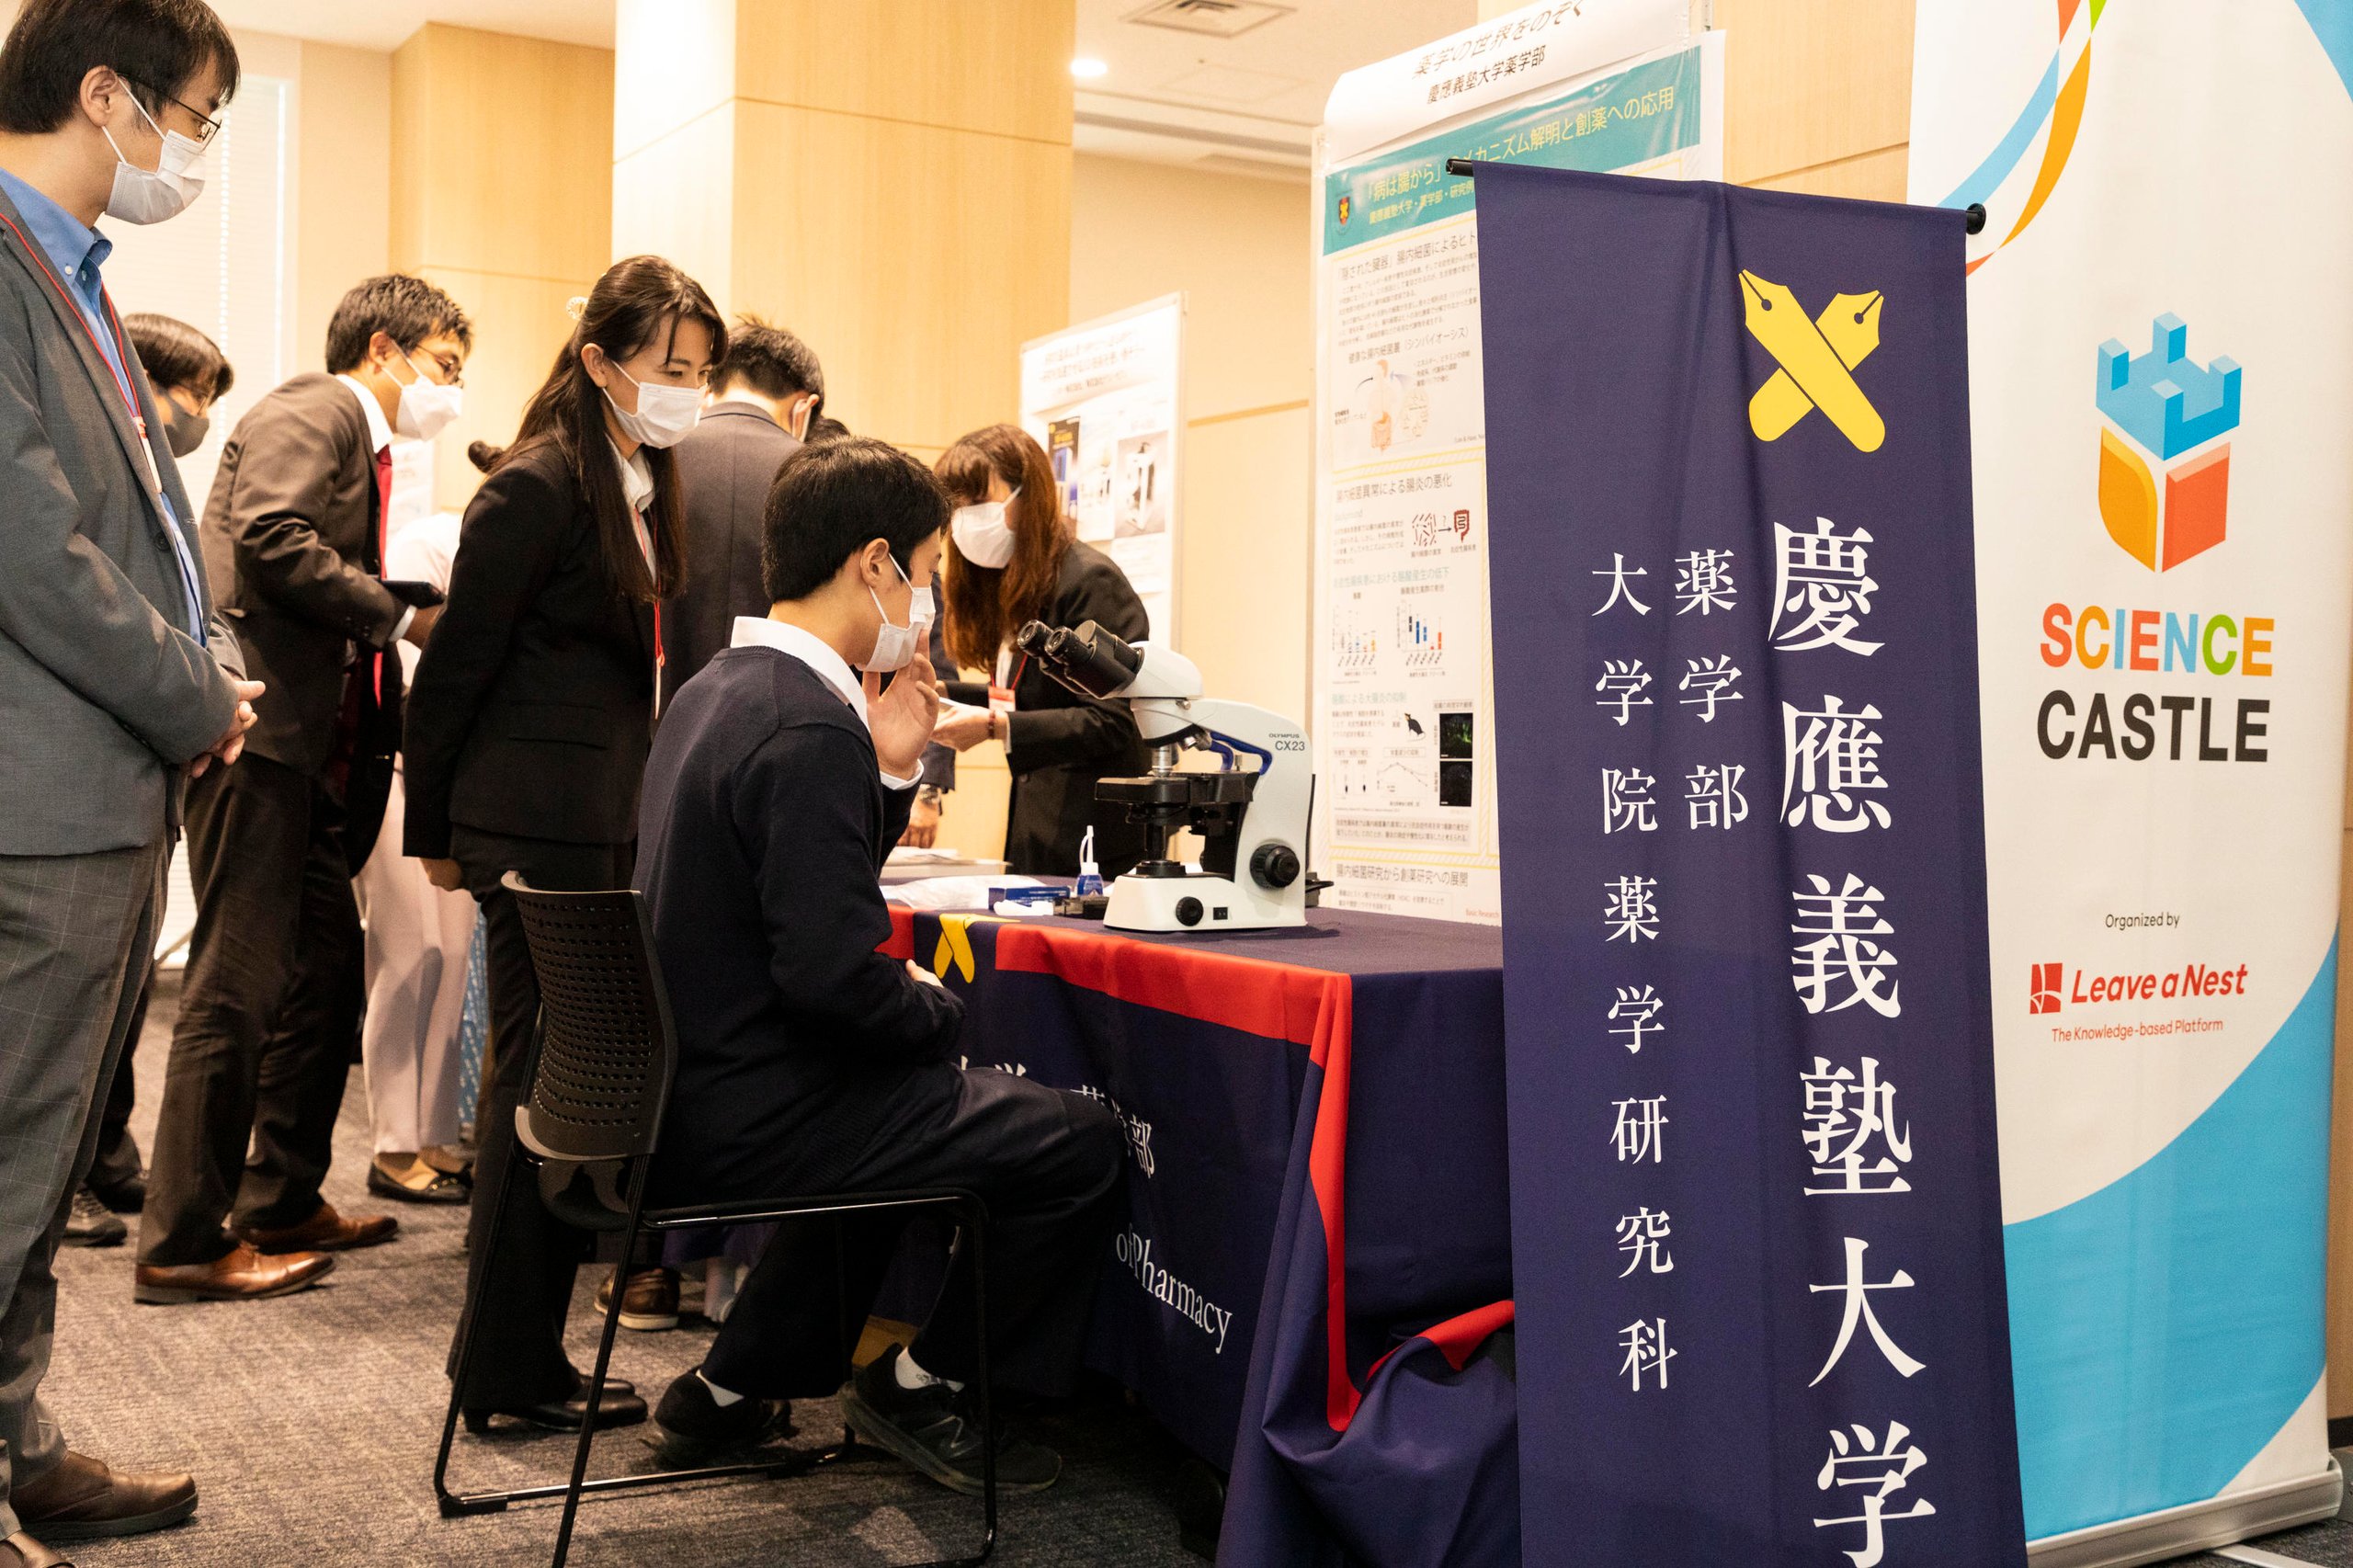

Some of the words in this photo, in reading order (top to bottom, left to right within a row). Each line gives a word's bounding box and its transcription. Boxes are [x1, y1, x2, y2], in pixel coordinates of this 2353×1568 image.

[2040, 603, 2275, 677] SCIENCE
[1675, 549, 1749, 830] 薬学部
[2037, 689, 2270, 763] CASTLE
[1275, 741, 1305, 751] CX23
[2105, 913, 2164, 930] Organized
[2166, 912, 2180, 928] by
[1592, 552, 1678, 1392] 大学院薬学研究科
[2071, 970, 2157, 1004] Leave
[2161, 973, 2179, 998] a
[2181, 963, 2248, 997] Nest
[1768, 517, 1937, 1568] 慶應義塾大学
[2052, 1028, 2073, 1042] The
[2074, 1019, 2173, 1040] Knowledge-based
[2175, 1017, 2223, 1034] Platform
[1131, 1233, 1233, 1355] Pharmacy
